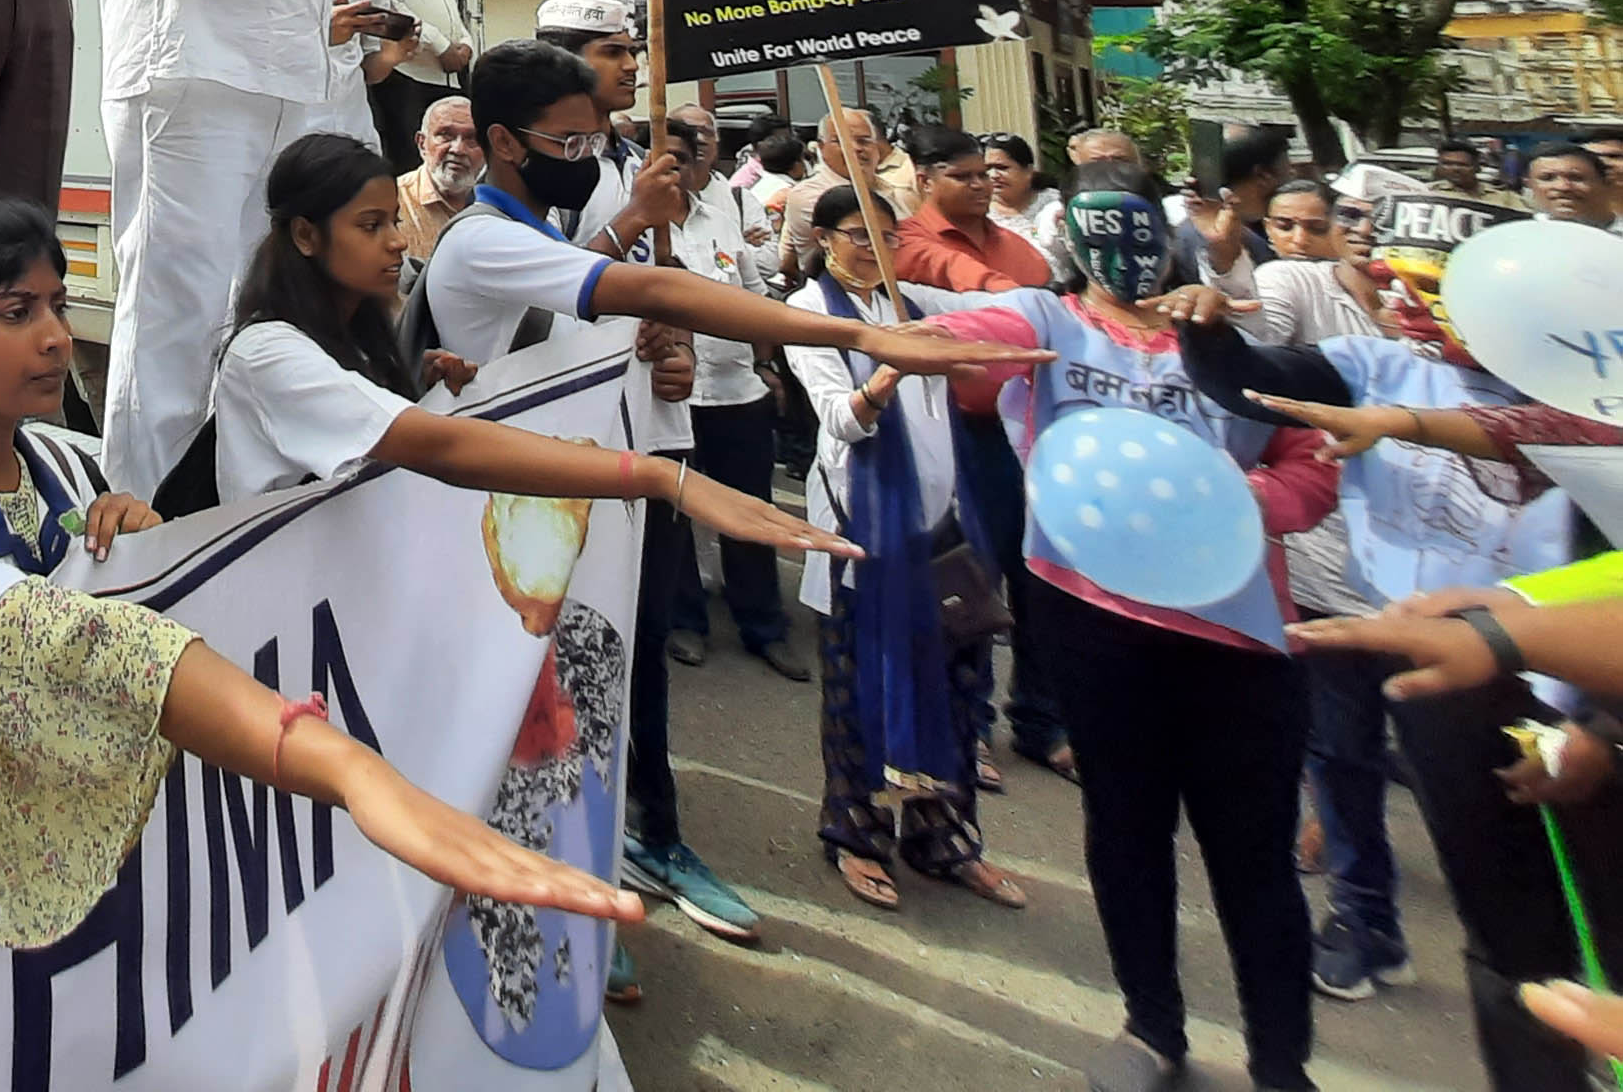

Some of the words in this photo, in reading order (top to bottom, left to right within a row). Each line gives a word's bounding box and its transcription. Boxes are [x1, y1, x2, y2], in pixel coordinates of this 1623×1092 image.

[684, 10, 713, 28] No
[715, 3, 765, 22] More
[711, 46, 760, 68] Unite
[763, 42, 793, 59] For
[795, 34, 855, 54] World
[856, 27, 922, 47] Peace
[1072, 206, 1124, 237] YES
[1132, 211, 1153, 243] NO
